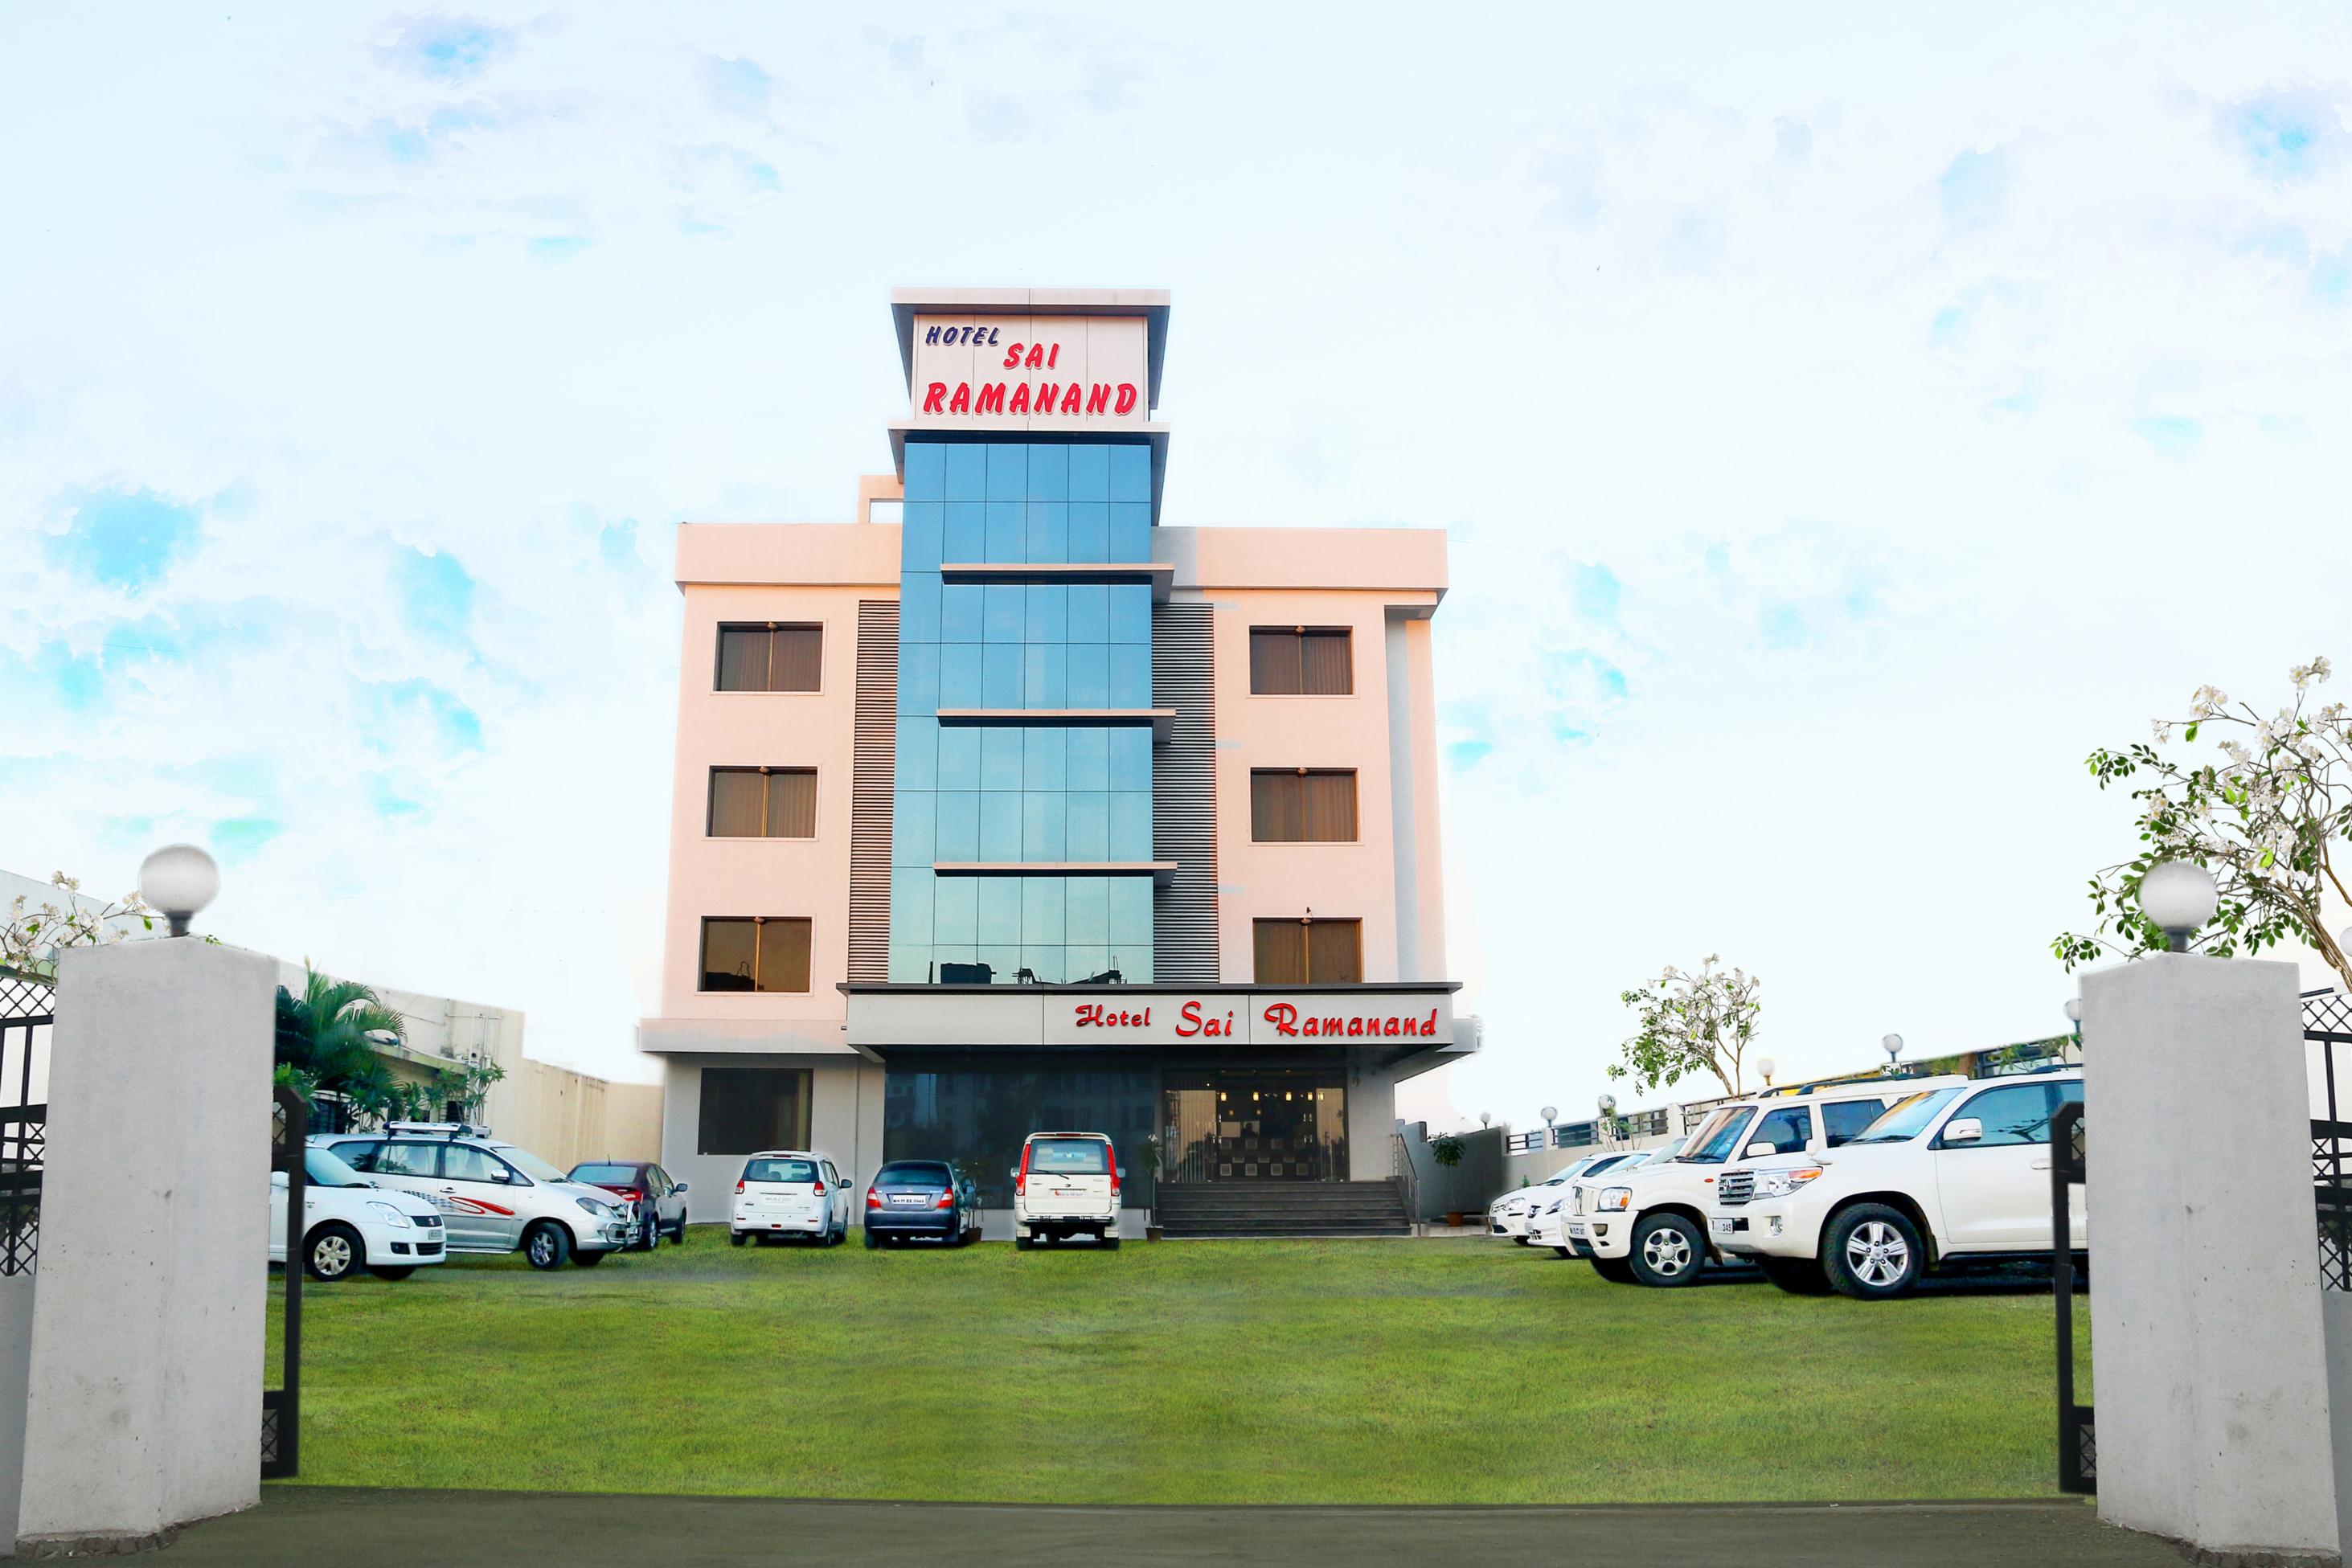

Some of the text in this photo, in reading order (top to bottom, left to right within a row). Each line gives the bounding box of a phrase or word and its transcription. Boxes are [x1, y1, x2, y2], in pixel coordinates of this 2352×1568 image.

[925, 325, 1000, 346] HOTEL
[1003, 342, 1060, 369] SAI
[923, 382, 1138, 416] RAMANAND
[1075, 1001, 1438, 1037] Hotel Sai Ramanand
